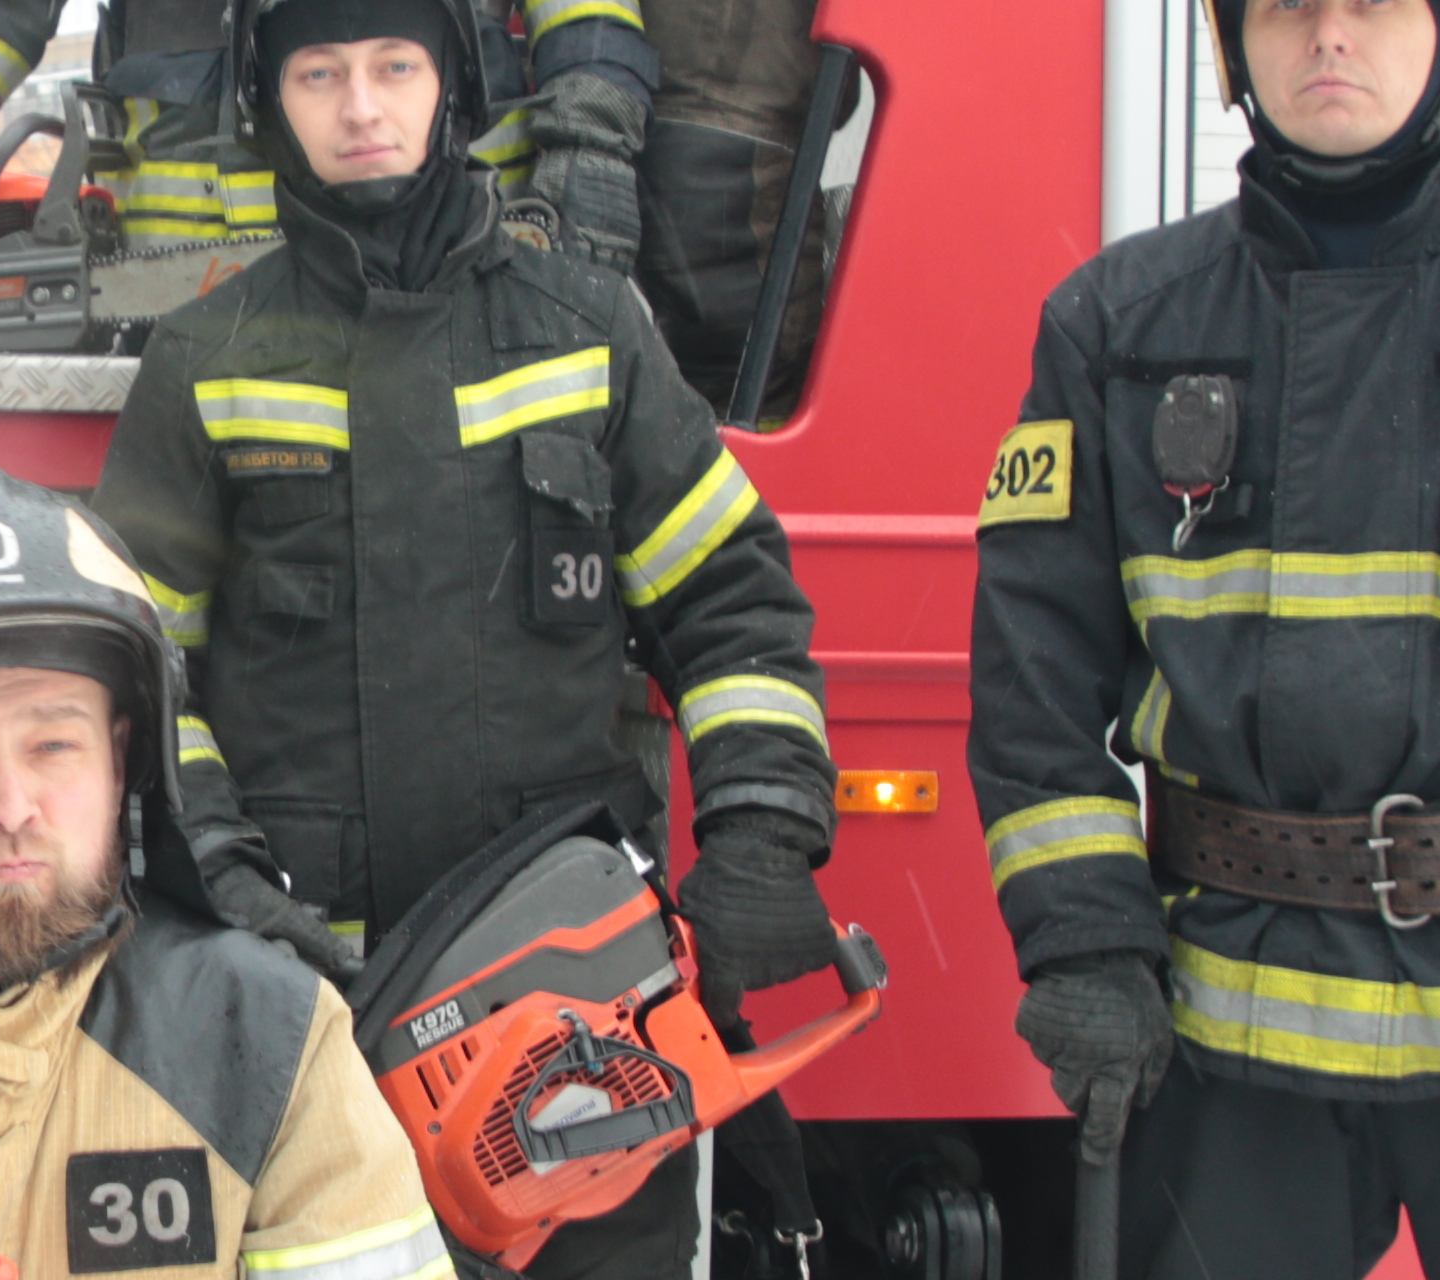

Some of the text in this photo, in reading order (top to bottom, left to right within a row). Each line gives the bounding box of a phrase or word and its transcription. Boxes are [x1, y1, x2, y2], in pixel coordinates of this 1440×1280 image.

[985, 444, 1056, 501] 302
[551, 552, 603, 599] 30
[416, 1013, 465, 1051] RESCUE
[87, 1177, 191, 1246] 30
